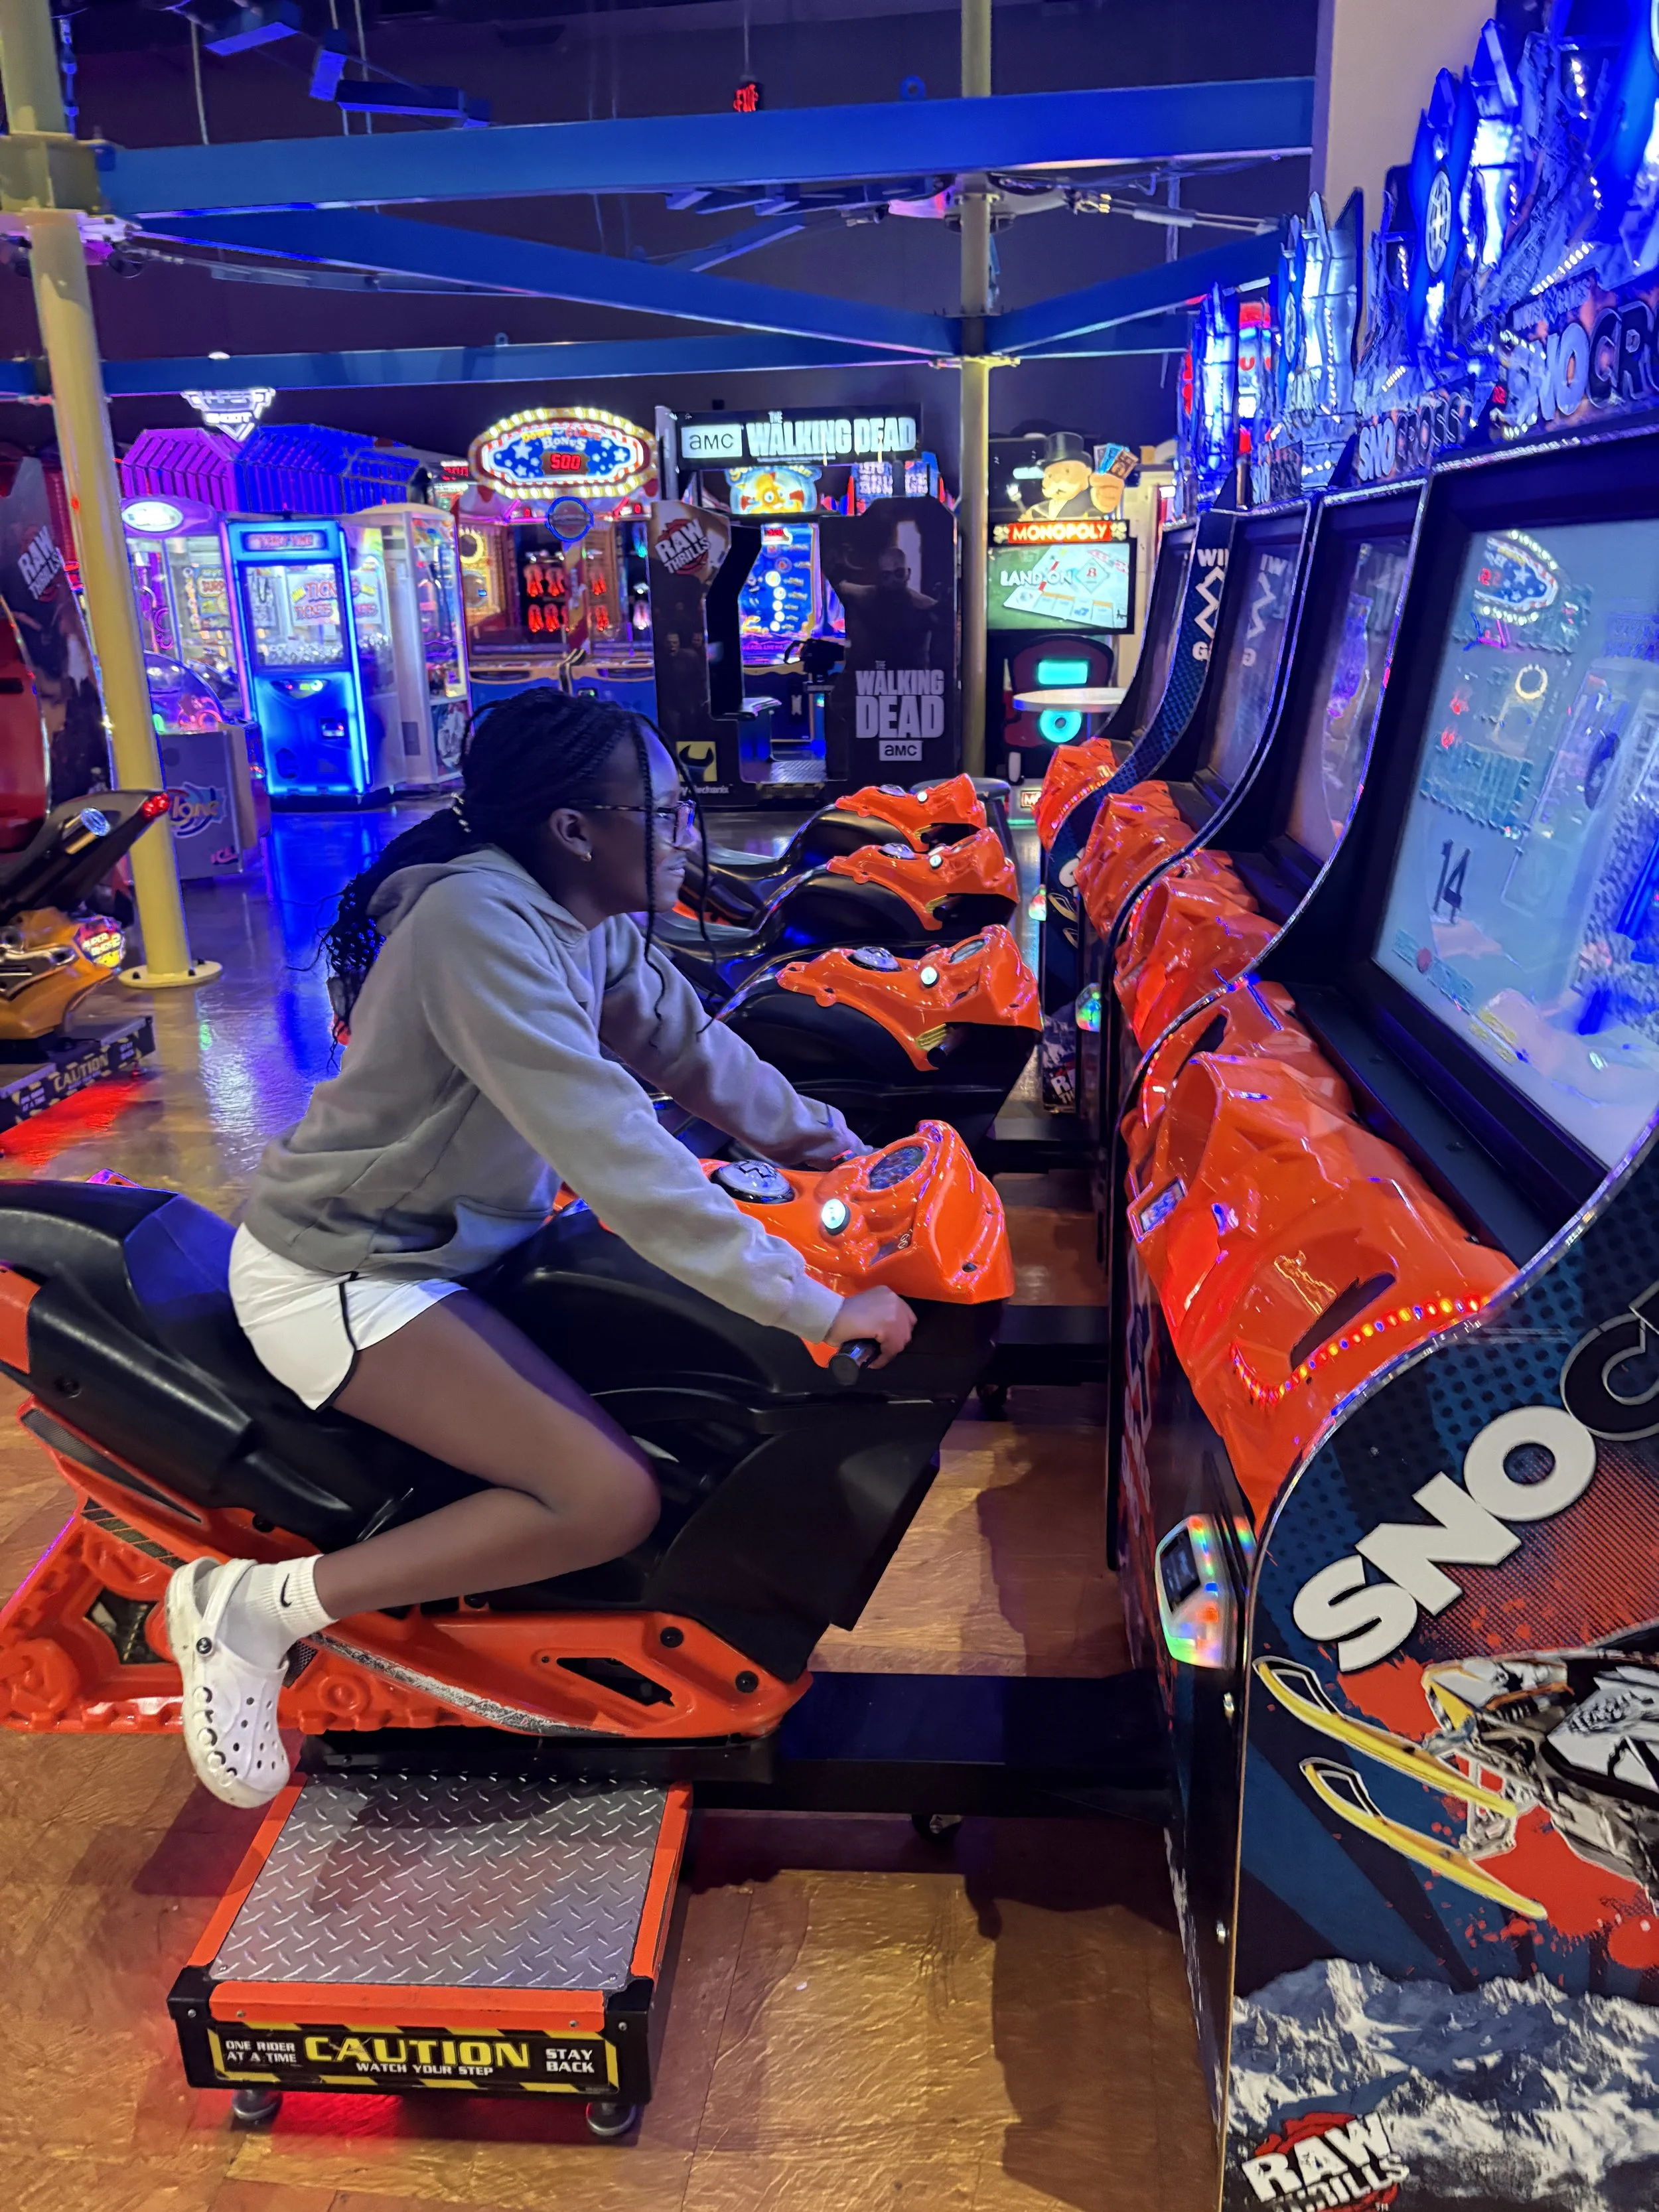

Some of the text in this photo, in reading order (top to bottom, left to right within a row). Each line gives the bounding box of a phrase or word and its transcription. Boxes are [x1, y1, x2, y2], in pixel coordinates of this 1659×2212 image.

[768, 411, 783, 423] THE
[745, 419, 853, 457] WALKING
[853, 417, 916, 453] DEAD
[549, 453, 581, 471] 500
[654, 518, 704, 563] RAW
[1012, 522, 1108, 541] MONOPOLY
[17, 525, 54, 585] RAW
[664, 536, 711, 574] THRILLS
[1000, 569, 1072, 586] LAND ON
[855, 670, 945, 696] WALKING
[855, 695, 945, 739] DEAD
[53, 1053, 110, 1092] CAUTION
[226, 2040, 295, 2052] ONE RIDER
[226, 2051, 297, 2063] AT A TIME
[304, 2037, 530, 2068] CAUTION
[545, 2048, 593, 2061] STAY
[356, 2062, 494, 2076] WATCH YOUR STEP
[546, 2061, 595, 2073] BACK
[1242, 2110, 1390, 2203] RAW
